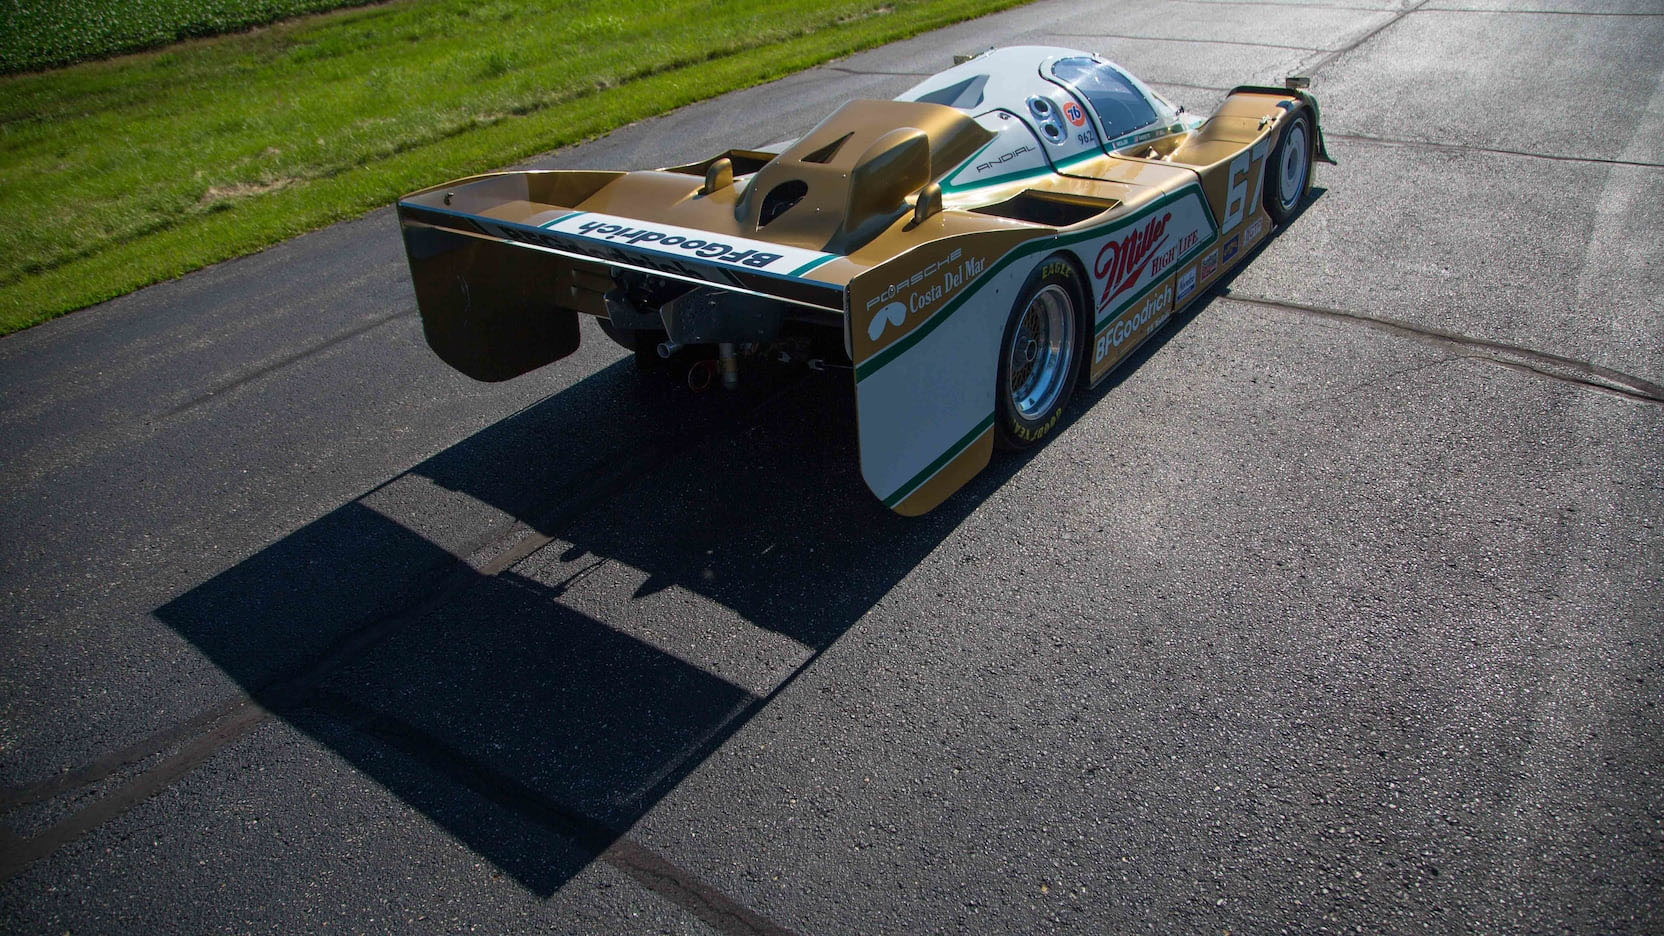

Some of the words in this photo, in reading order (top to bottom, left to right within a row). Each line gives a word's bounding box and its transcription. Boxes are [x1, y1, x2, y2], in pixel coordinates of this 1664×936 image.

[1067, 106, 1081, 121] 76
[1078, 130, 1094, 145] 962
[976, 145, 1036, 173] ANDIAL
[1222, 137, 1270, 235] 67
[578, 220, 784, 269] BFGoodrich
[1094, 212, 1172, 306] Miller
[1151, 245, 1176, 278] HIGH
[1178, 228, 1199, 255] LIFE
[909, 284, 943, 314] Costa
[944, 264, 964, 294] Del
[964, 255, 986, 281] Mar
[1041, 261, 1072, 280] EAGLE
[1095, 285, 1172, 364] BFGoodrich
